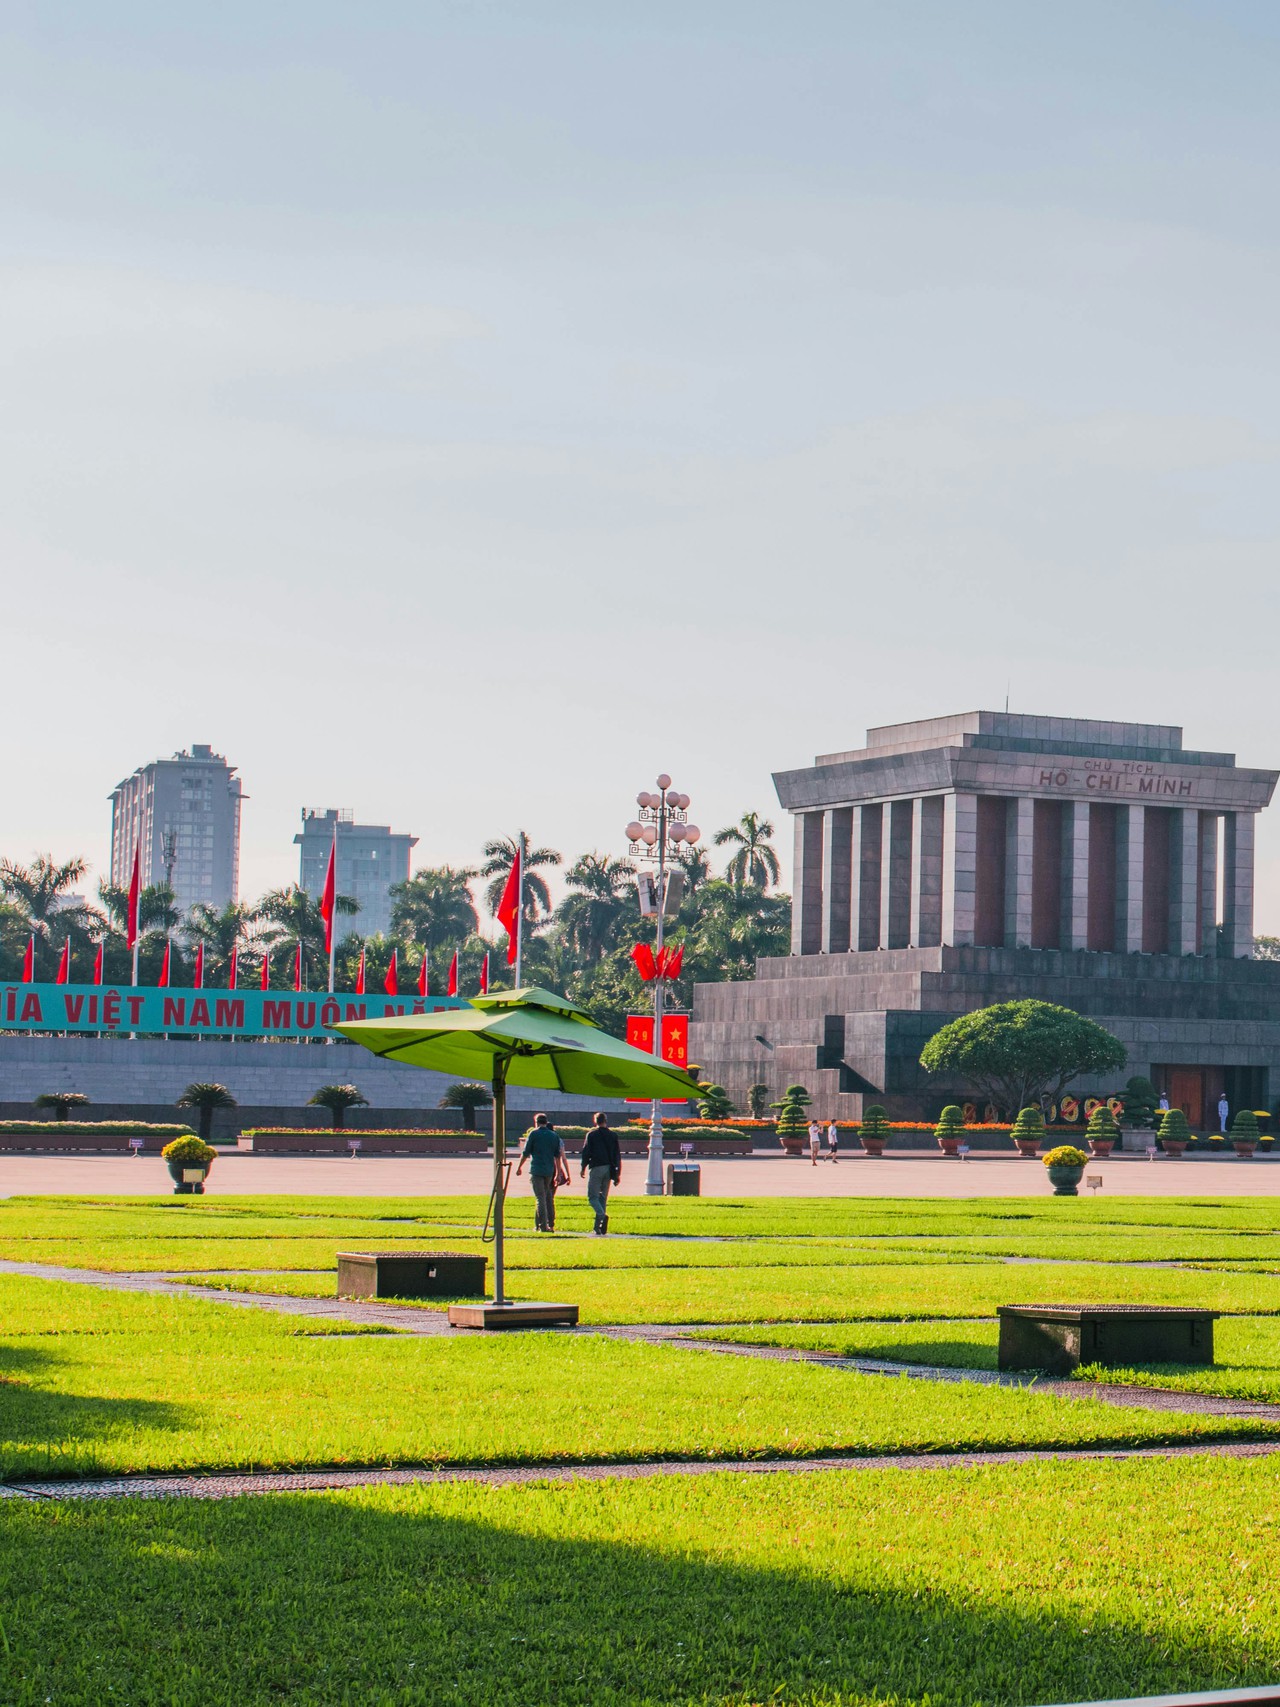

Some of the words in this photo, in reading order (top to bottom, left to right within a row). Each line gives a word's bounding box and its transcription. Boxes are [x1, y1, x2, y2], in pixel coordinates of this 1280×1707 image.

[0, 986, 43, 1022] ĨA
[64, 989, 145, 1030] VIỆT
[163, 997, 245, 1028] NAM
